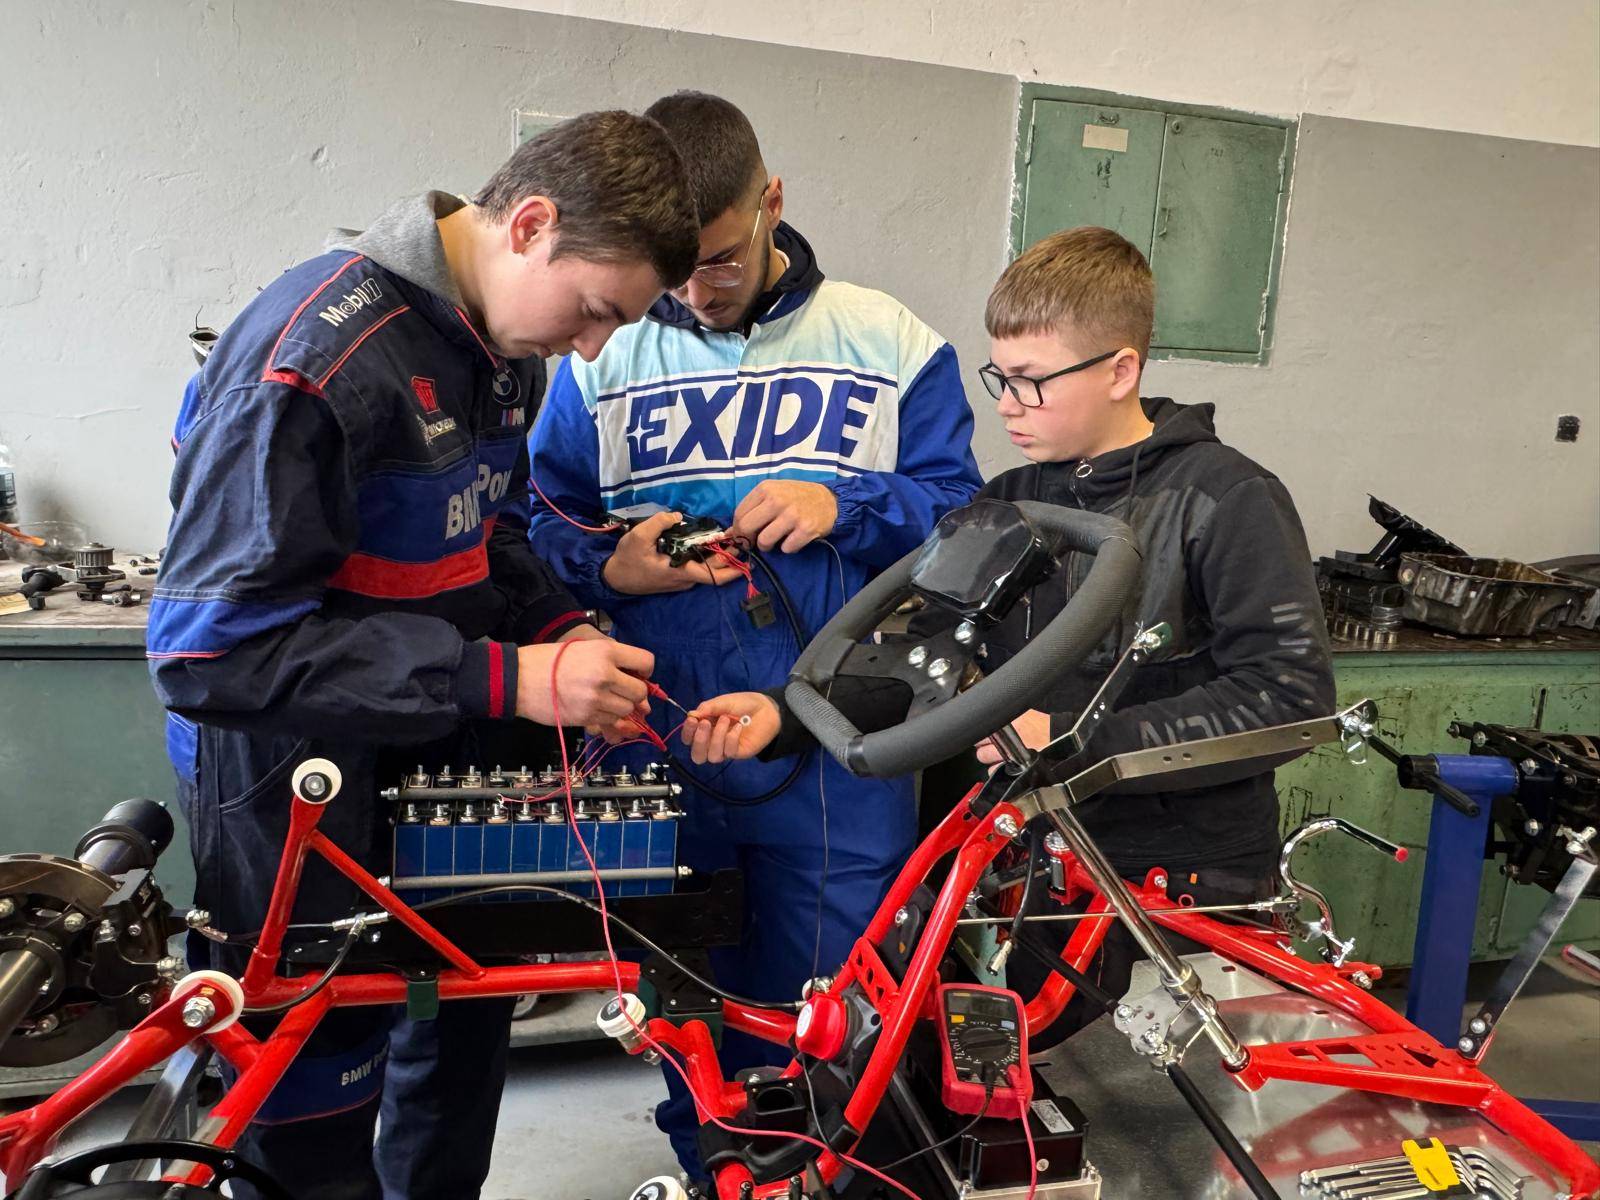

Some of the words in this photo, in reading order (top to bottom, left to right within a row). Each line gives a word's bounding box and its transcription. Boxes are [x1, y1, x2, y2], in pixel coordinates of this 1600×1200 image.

[318, 287, 373, 327] Mobil
[626, 377, 878, 471] EXIDE
[444, 480, 481, 541] BM
[341, 1059, 373, 1087] BMW
